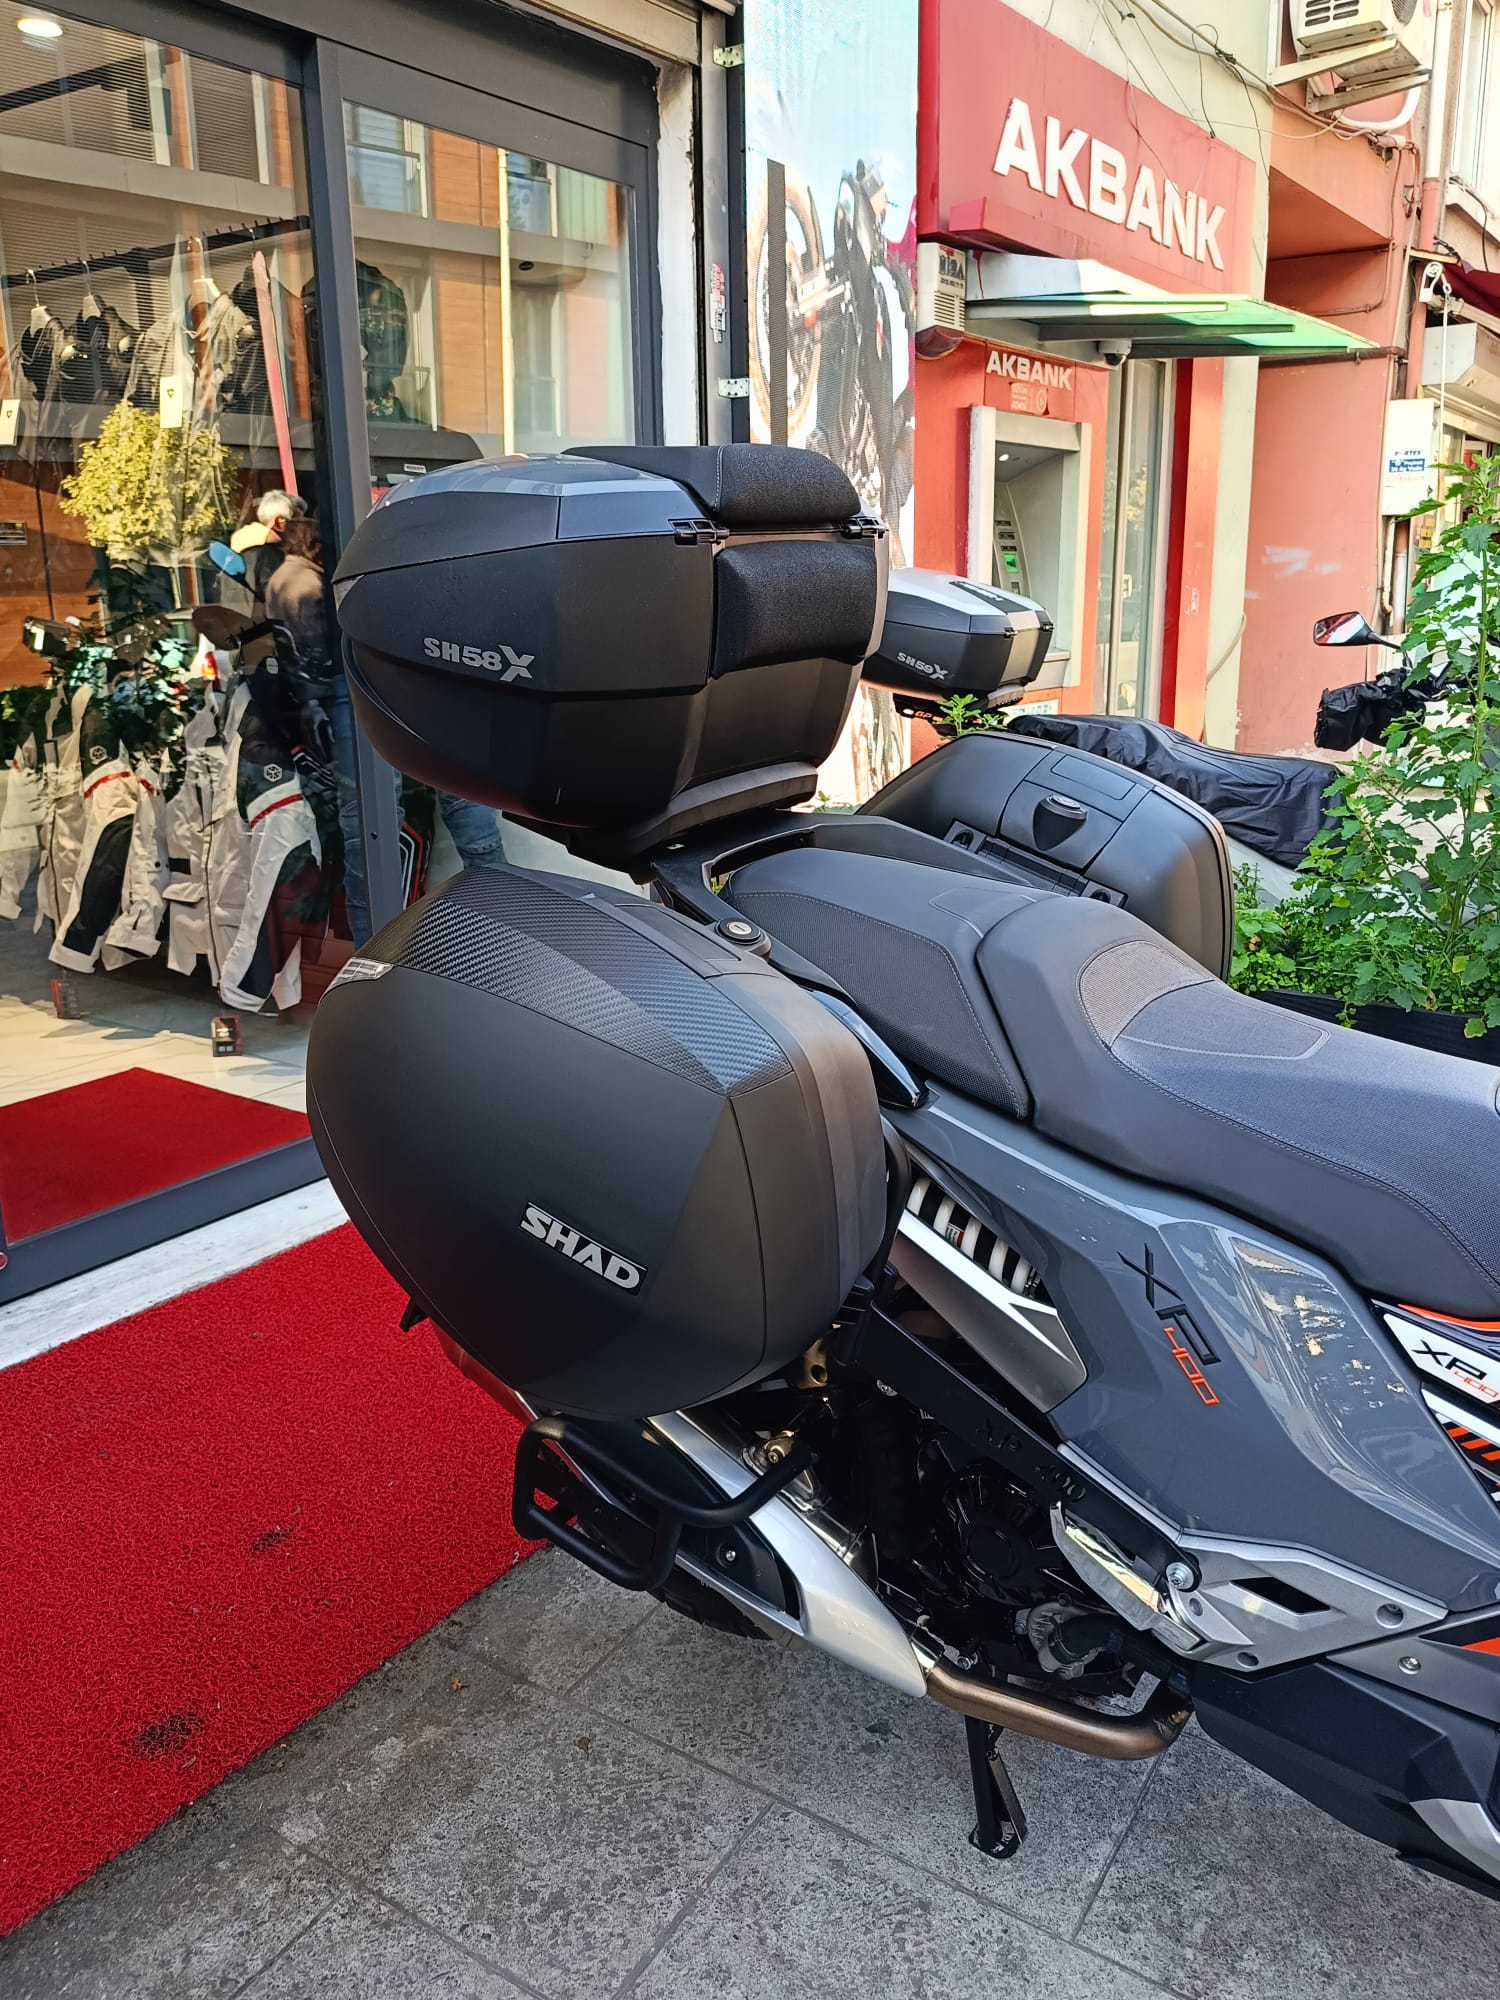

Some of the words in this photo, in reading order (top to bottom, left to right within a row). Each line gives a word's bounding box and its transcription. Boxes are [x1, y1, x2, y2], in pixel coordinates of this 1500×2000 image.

[993, 97, 1226, 272] AKBANK
[986, 350, 1073, 391] AKBANK
[423, 637, 535, 682] SH58X
[897, 652, 949, 680] SH59X
[520, 1206, 640, 1289] SHAD
[1117, 1242, 1222, 1366] XP
[1163, 1327, 1220, 1406] 400
[1411, 1339, 1488, 1381] XP
[1454, 1370, 1500, 1398] 400
